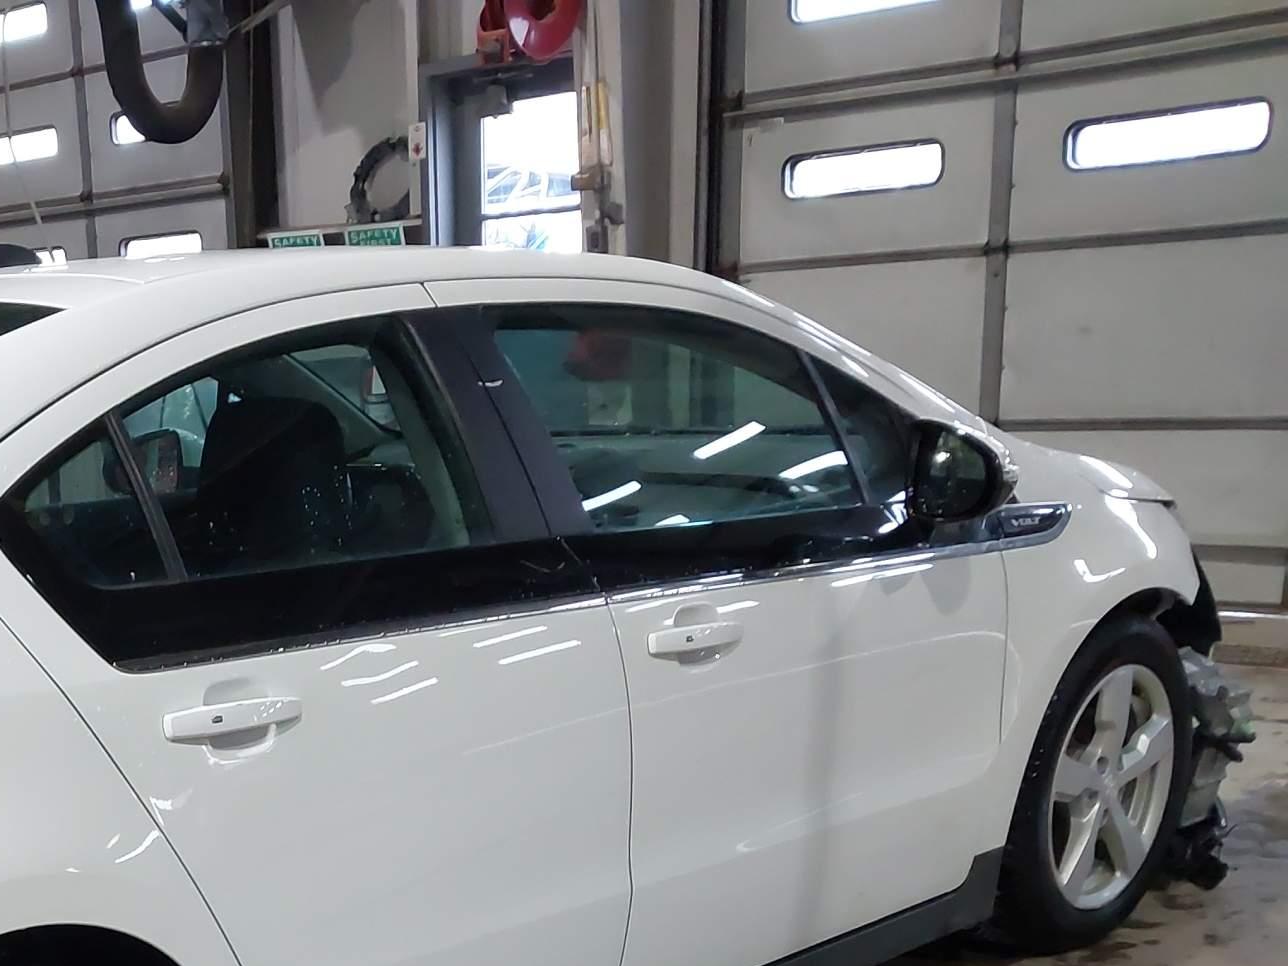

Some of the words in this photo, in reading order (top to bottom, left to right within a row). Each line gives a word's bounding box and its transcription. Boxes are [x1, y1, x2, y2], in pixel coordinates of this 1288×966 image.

[274, 235, 318, 247] SAFETY
[350, 229, 398, 243] SAFETY
[1012, 517, 1040, 526] VOLT
